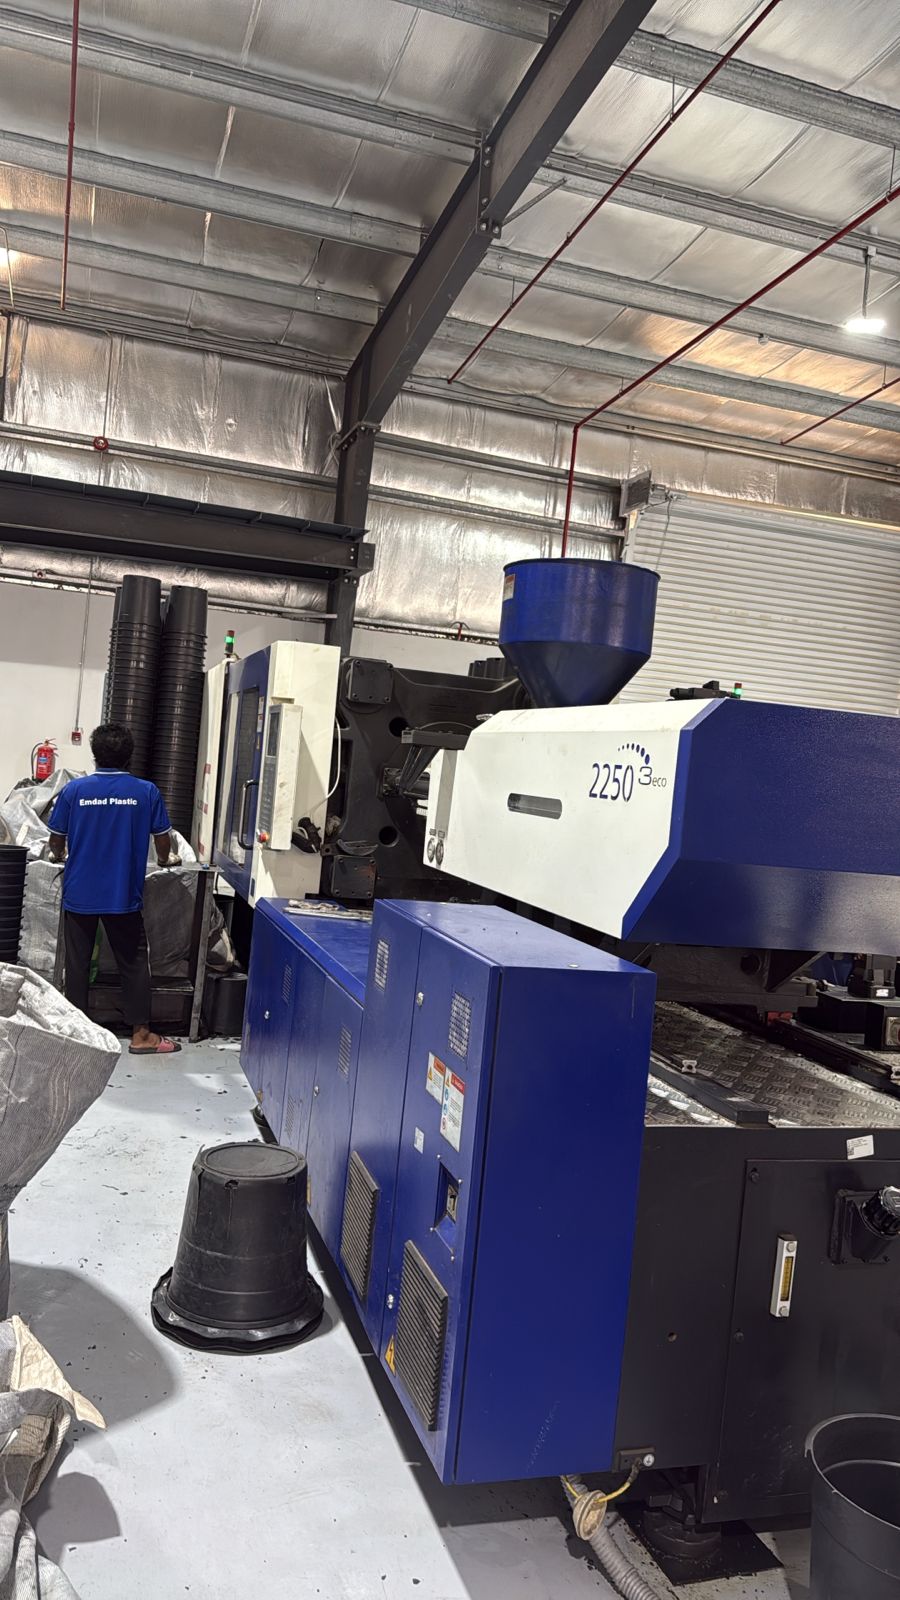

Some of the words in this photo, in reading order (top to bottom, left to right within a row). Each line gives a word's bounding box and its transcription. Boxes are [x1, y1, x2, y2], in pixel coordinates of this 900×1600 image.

[588, 763, 634, 803] 2250
[79, 798, 107, 806] Emdad
[109, 798, 138, 806] Plastic
